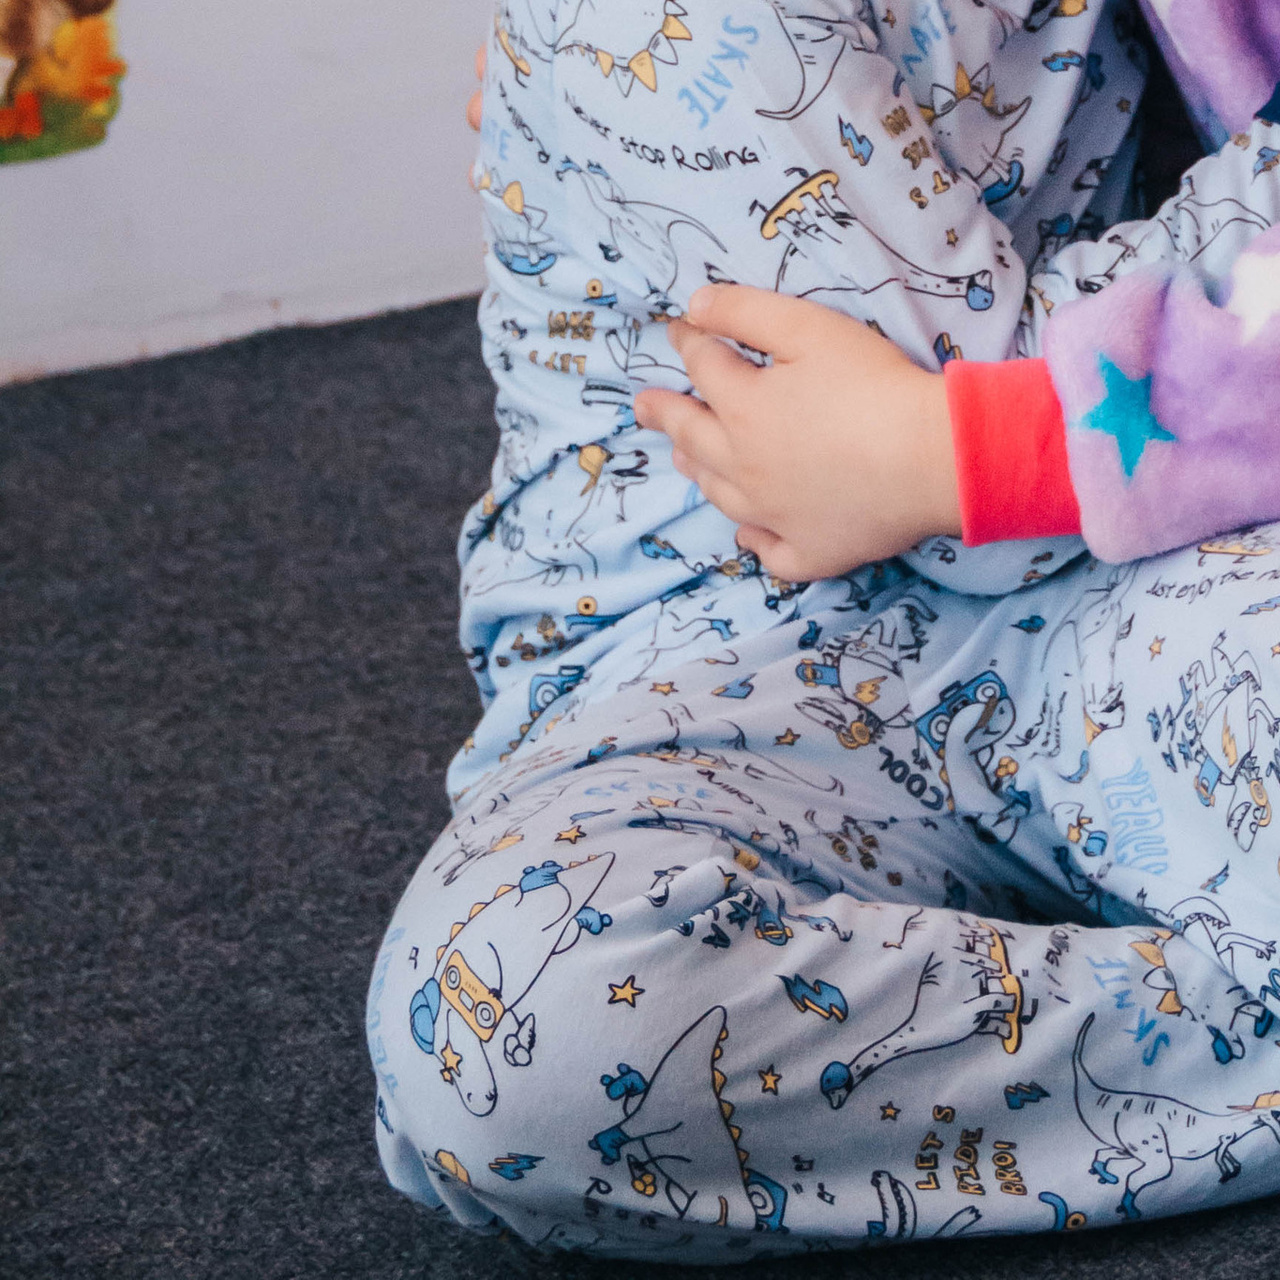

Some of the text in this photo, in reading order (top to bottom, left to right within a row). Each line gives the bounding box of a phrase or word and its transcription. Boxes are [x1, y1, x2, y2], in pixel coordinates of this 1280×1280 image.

[678, 14, 760, 130] SKATE
[878, 745, 945, 812] COOL
[952, 1126, 987, 1197] RIDE
